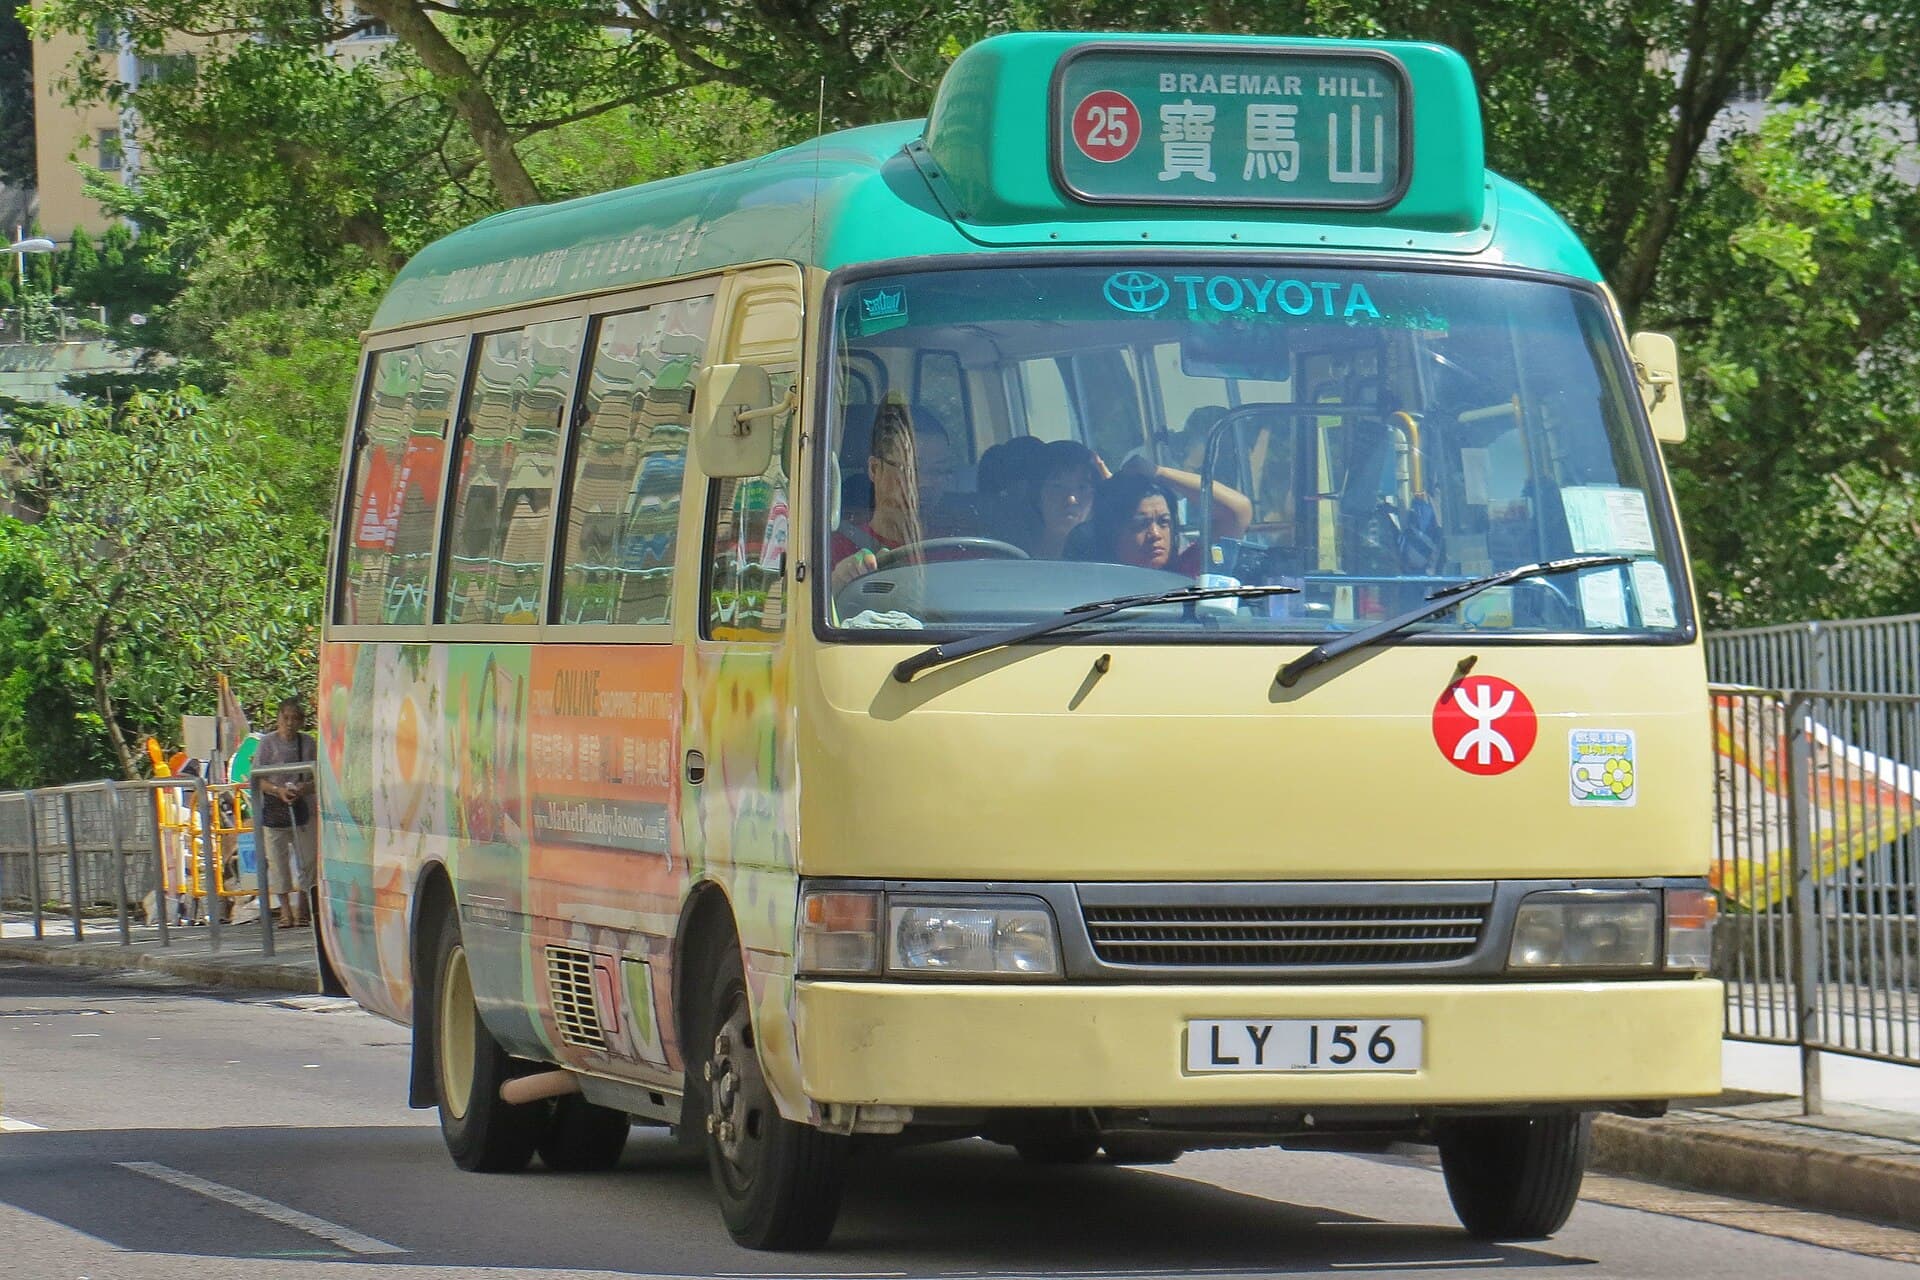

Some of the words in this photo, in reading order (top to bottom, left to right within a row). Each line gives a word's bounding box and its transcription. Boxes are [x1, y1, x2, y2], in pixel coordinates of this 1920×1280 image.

[1159, 73, 1302, 96] BRAEMAR
[1318, 77, 1384, 98] HILL
[1086, 106, 1128, 147] 25
[1158, 99, 1384, 184] 寶馬山
[1173, 275, 1380, 318] TOYOTA
[553, 669, 601, 717] ONLINE
[1211, 1025, 1273, 1065] LY
[1310, 1025, 1396, 1065] 156
